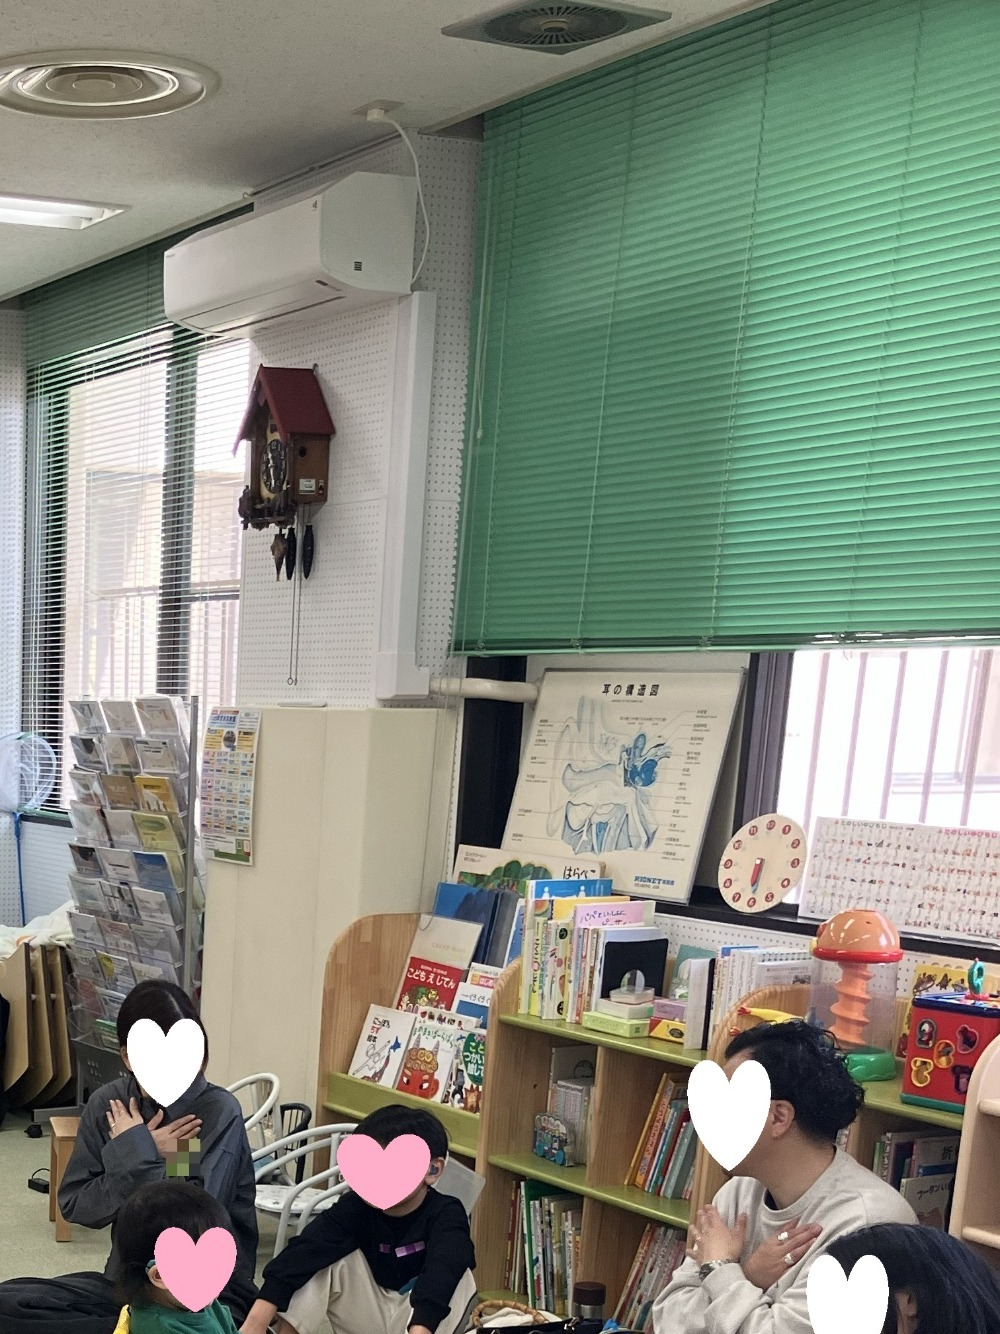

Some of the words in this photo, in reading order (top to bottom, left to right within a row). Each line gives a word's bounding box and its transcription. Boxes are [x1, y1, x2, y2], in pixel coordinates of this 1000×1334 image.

[602, 683, 660, 697] 耳の構造図
[407, 967, 426, 982] こども
[427, 973, 435, 984] え
[435, 975, 456, 989] じてん
[366, 1034, 377, 1043] 絵本
